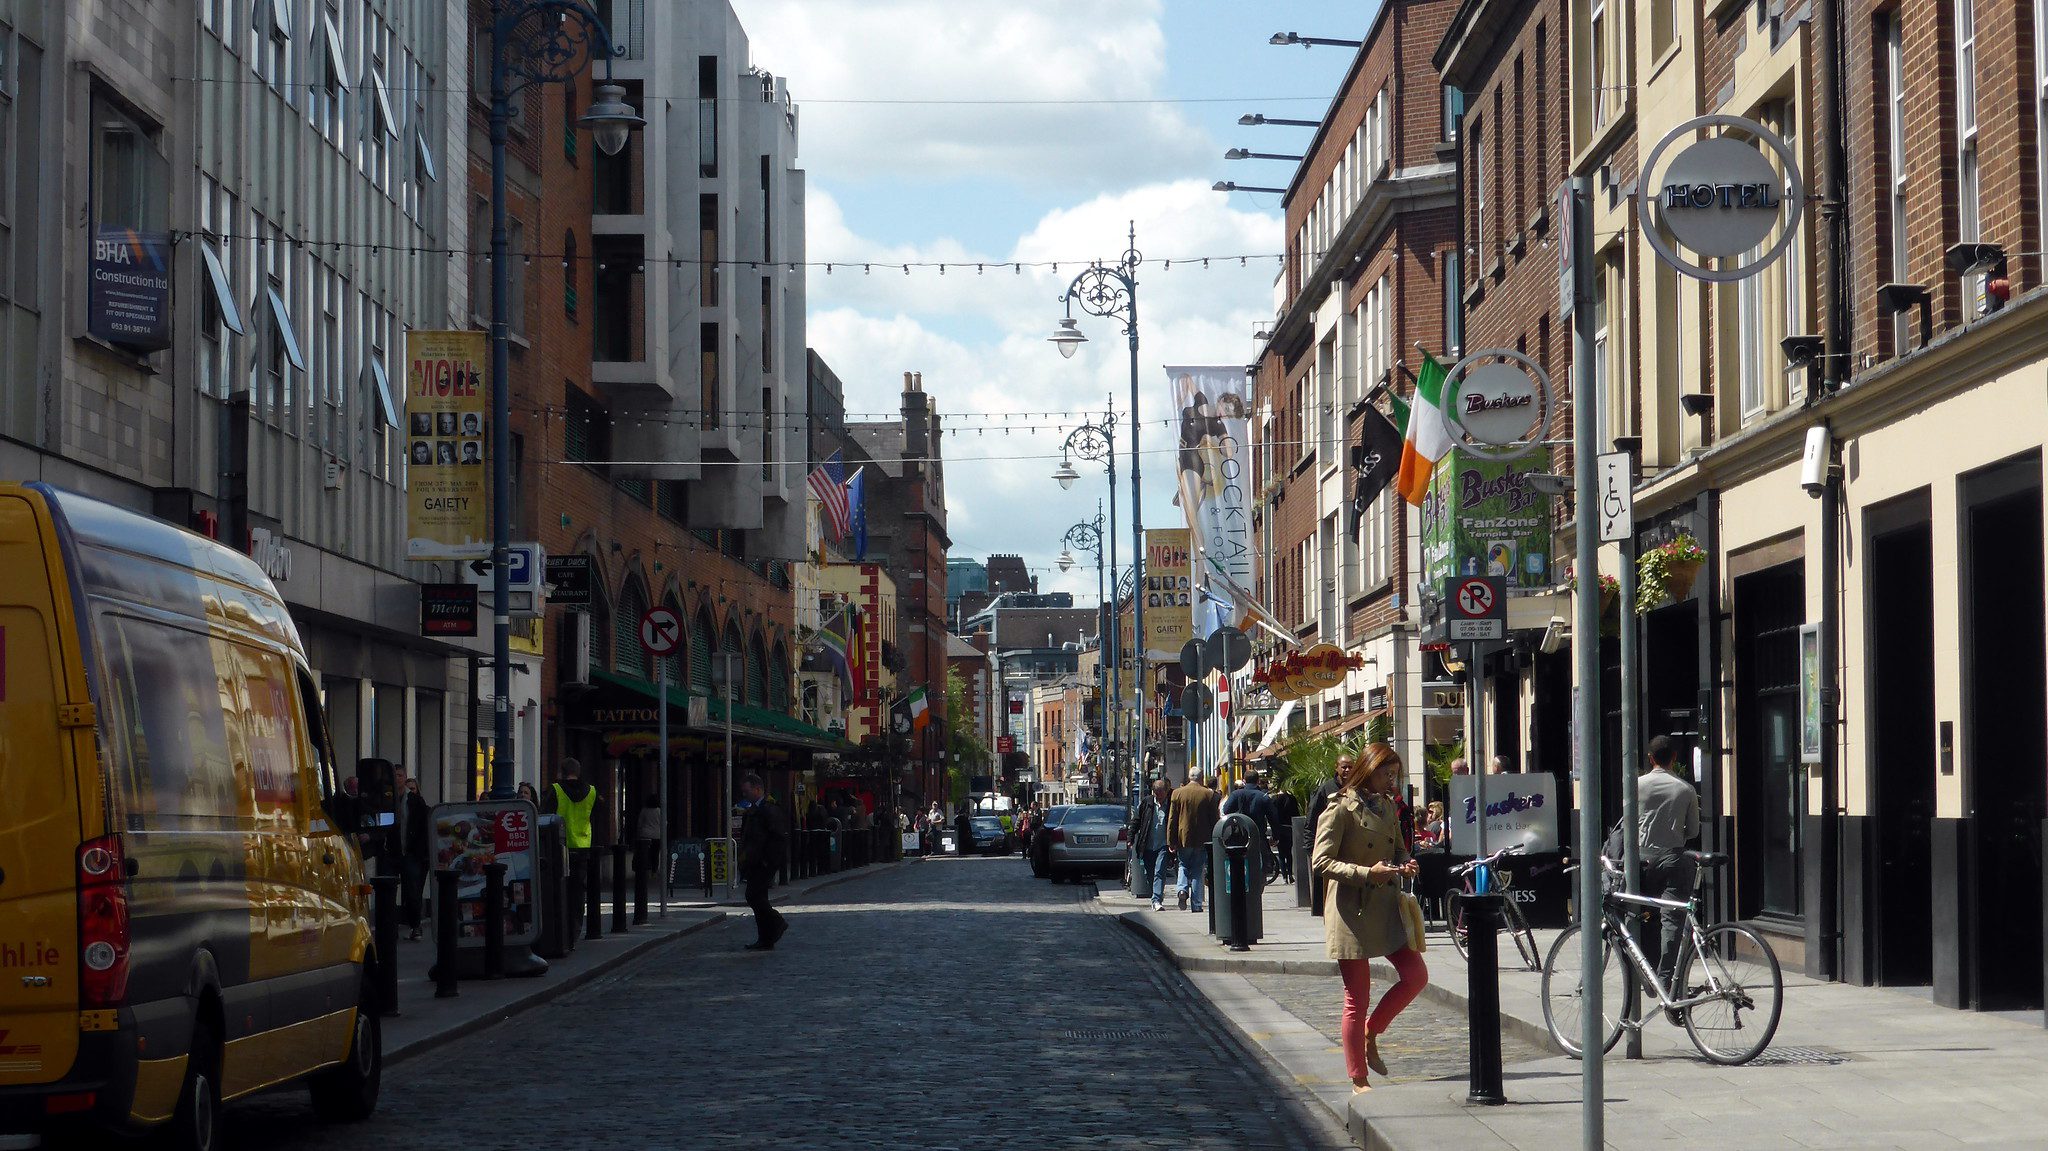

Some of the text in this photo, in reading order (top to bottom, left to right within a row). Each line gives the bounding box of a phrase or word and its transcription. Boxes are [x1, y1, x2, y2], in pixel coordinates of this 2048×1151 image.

[1664, 181, 1780, 209] HOTEL
[95, 239, 131, 265] BHA
[95, 268, 168, 290] Construction ltd
[414, 359, 476, 397] MOLL
[1465, 392, 1532, 415] Buskers
[424, 497, 469, 510] GAIETY
[1509, 487, 1538, 513] Bar
[1218, 436, 1251, 598] COCKTAIL
[1469, 529, 1532, 540] Temple Bar
[1149, 545, 1188, 568] MOLL
[431, 604, 470, 614] Metro
[1156, 625, 1184, 634] GAIETY
[1285, 650, 1365, 671] Hard Rock
[1314, 672, 1336, 680] CAFE
[502, 812, 530, 833] €3
[1506, 823, 1513, 832] &
[507, 840, 530, 848] Meats
